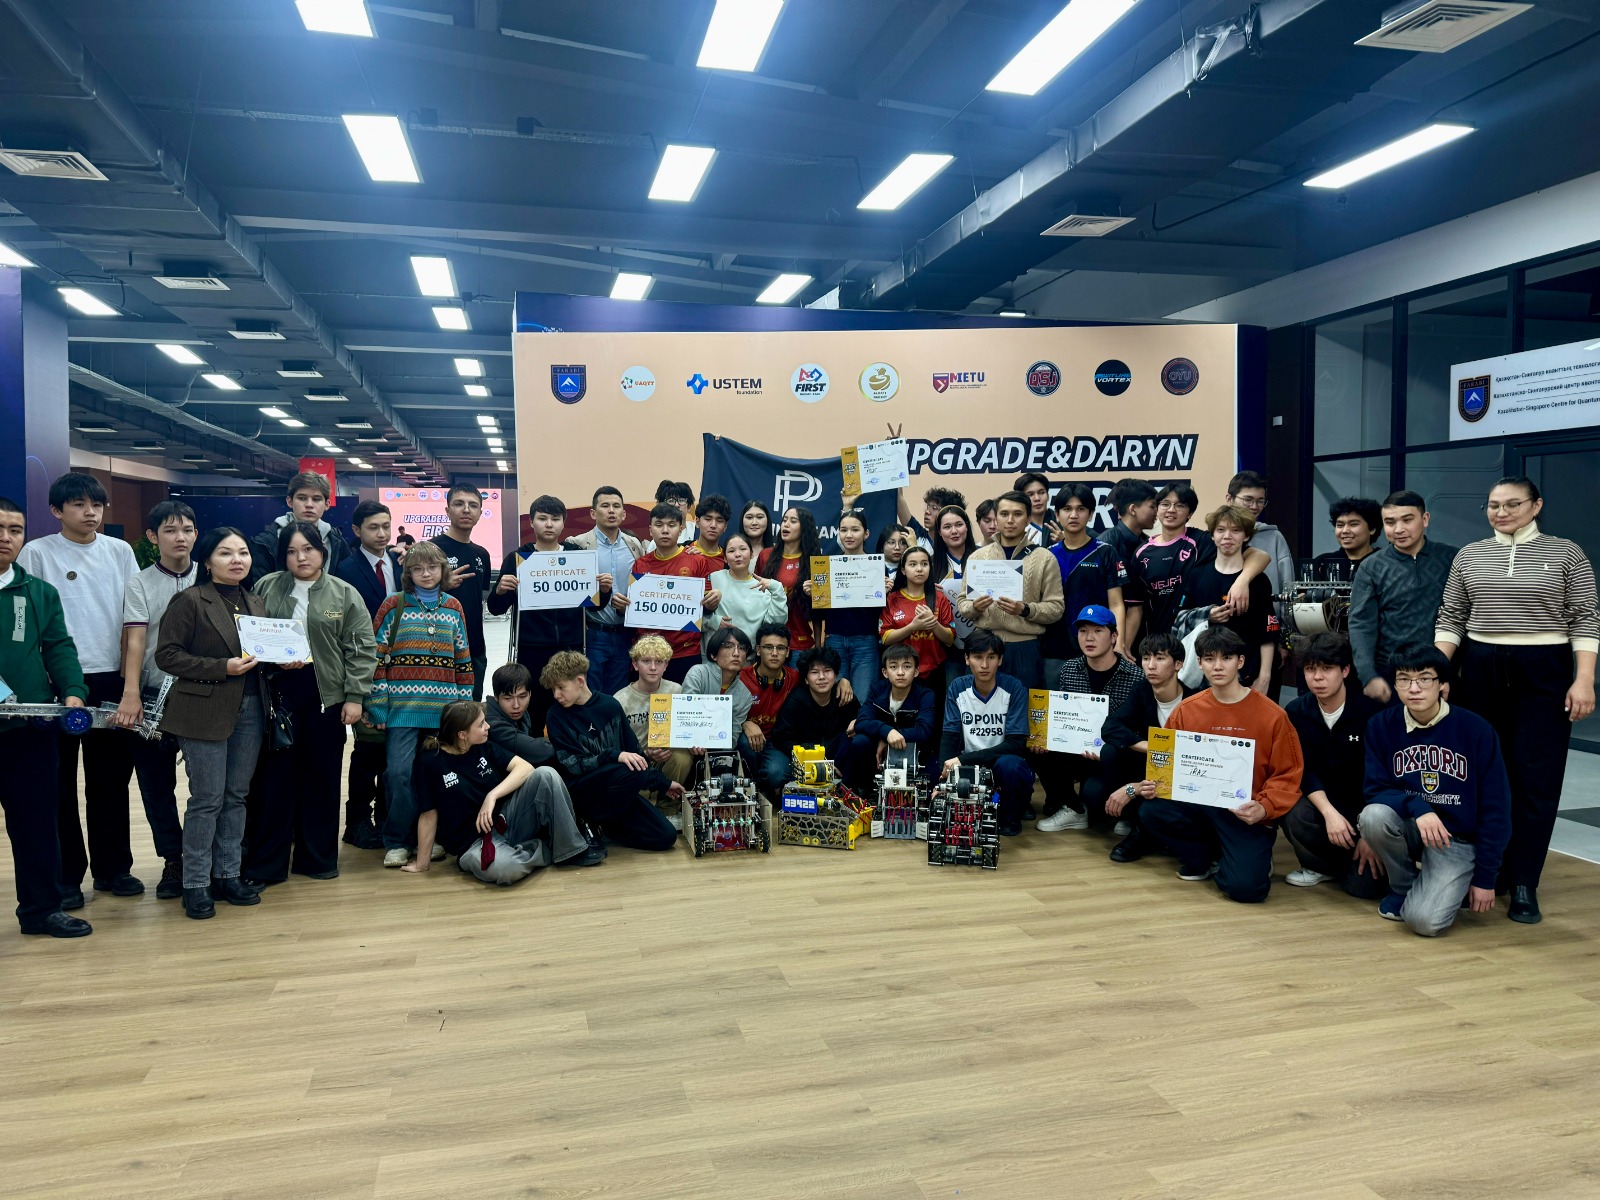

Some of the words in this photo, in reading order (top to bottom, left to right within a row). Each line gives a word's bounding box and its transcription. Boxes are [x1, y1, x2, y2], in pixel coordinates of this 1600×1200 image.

[712, 378, 762, 389] USTEM
[795, 383, 826, 392] FIRST
[1463, 379, 1485, 388] FARABI
[1563, 381, 1581, 389] центр
[1497, 402, 1550, 415] Kazakhstan-Singapore
[904, 437, 1195, 473] PGRADE&DARYN
[530, 568, 587, 577] CERTIFICATE
[533, 581, 550, 593] 50
[639, 590, 692, 601] CERTIFICATE
[634, 600, 658, 613] 150
[970, 727, 1004, 737] #22958
[1151, 753, 1169, 761] FIRST
[1181, 754, 1215, 763] CERTIFICATE
[1392, 744, 1468, 782] OXFORD
